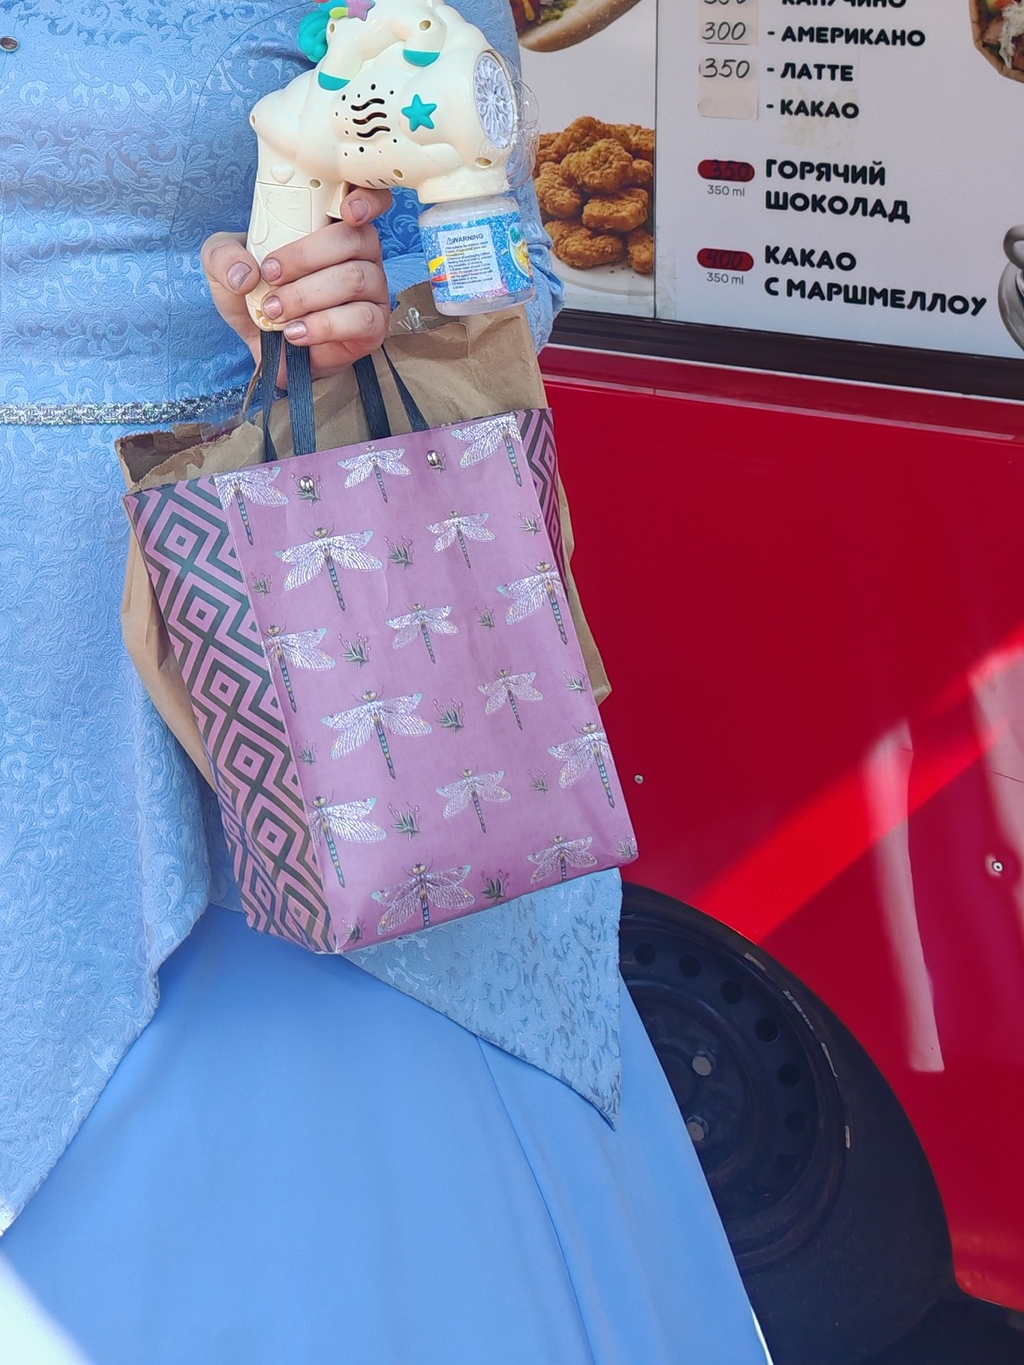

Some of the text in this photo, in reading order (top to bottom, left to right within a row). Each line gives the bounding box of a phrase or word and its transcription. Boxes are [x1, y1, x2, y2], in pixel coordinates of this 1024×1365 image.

[701, 21, 746, 40] 300
[781, 25, 926, 47] АМЕРИКАНО
[702, 58, 750, 79] 350
[780, 62, 854, 81] ЛАТТЕ
[780, 99, 859, 119] КАКАО
[766, 159, 886, 186] ГОРЯЧИЙ
[707, 184, 745, 197] 350 ml
[765, 190, 910, 223] ШОКОЛАД
[452, 233, 484, 244] WARNING
[765, 245, 856, 271] КАКАО
[706, 272, 744, 285] 350 ml
[764, 277, 987, 316] С МАРШМЕЛЛОУ
